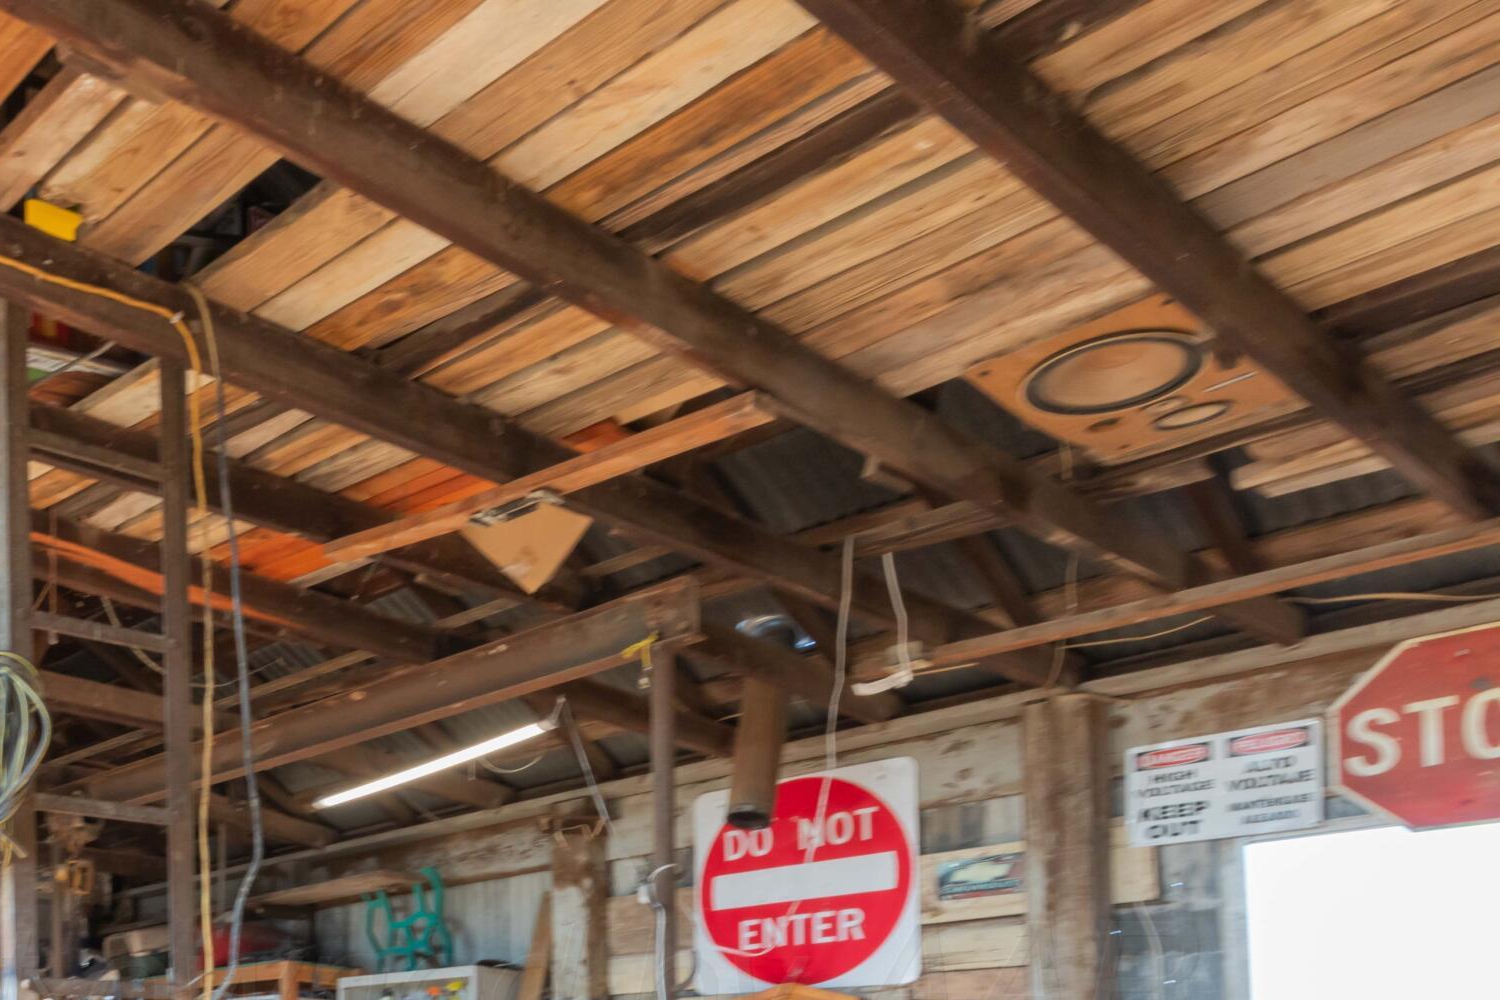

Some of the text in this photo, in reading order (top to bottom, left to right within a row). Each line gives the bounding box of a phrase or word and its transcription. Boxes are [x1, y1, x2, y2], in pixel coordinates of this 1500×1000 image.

[1244, 756, 1297, 774] ALTO
[1150, 769, 1196, 784] HIGH
[1225, 769, 1315, 791] VOLTAJE
[1136, 779, 1215, 797] VOLTAGE
[1140, 801, 1208, 821] KEEP
[723, 806, 880, 861] DO NOT
[1145, 820, 1203, 839] OUT
[738, 908, 866, 951] ENTER
